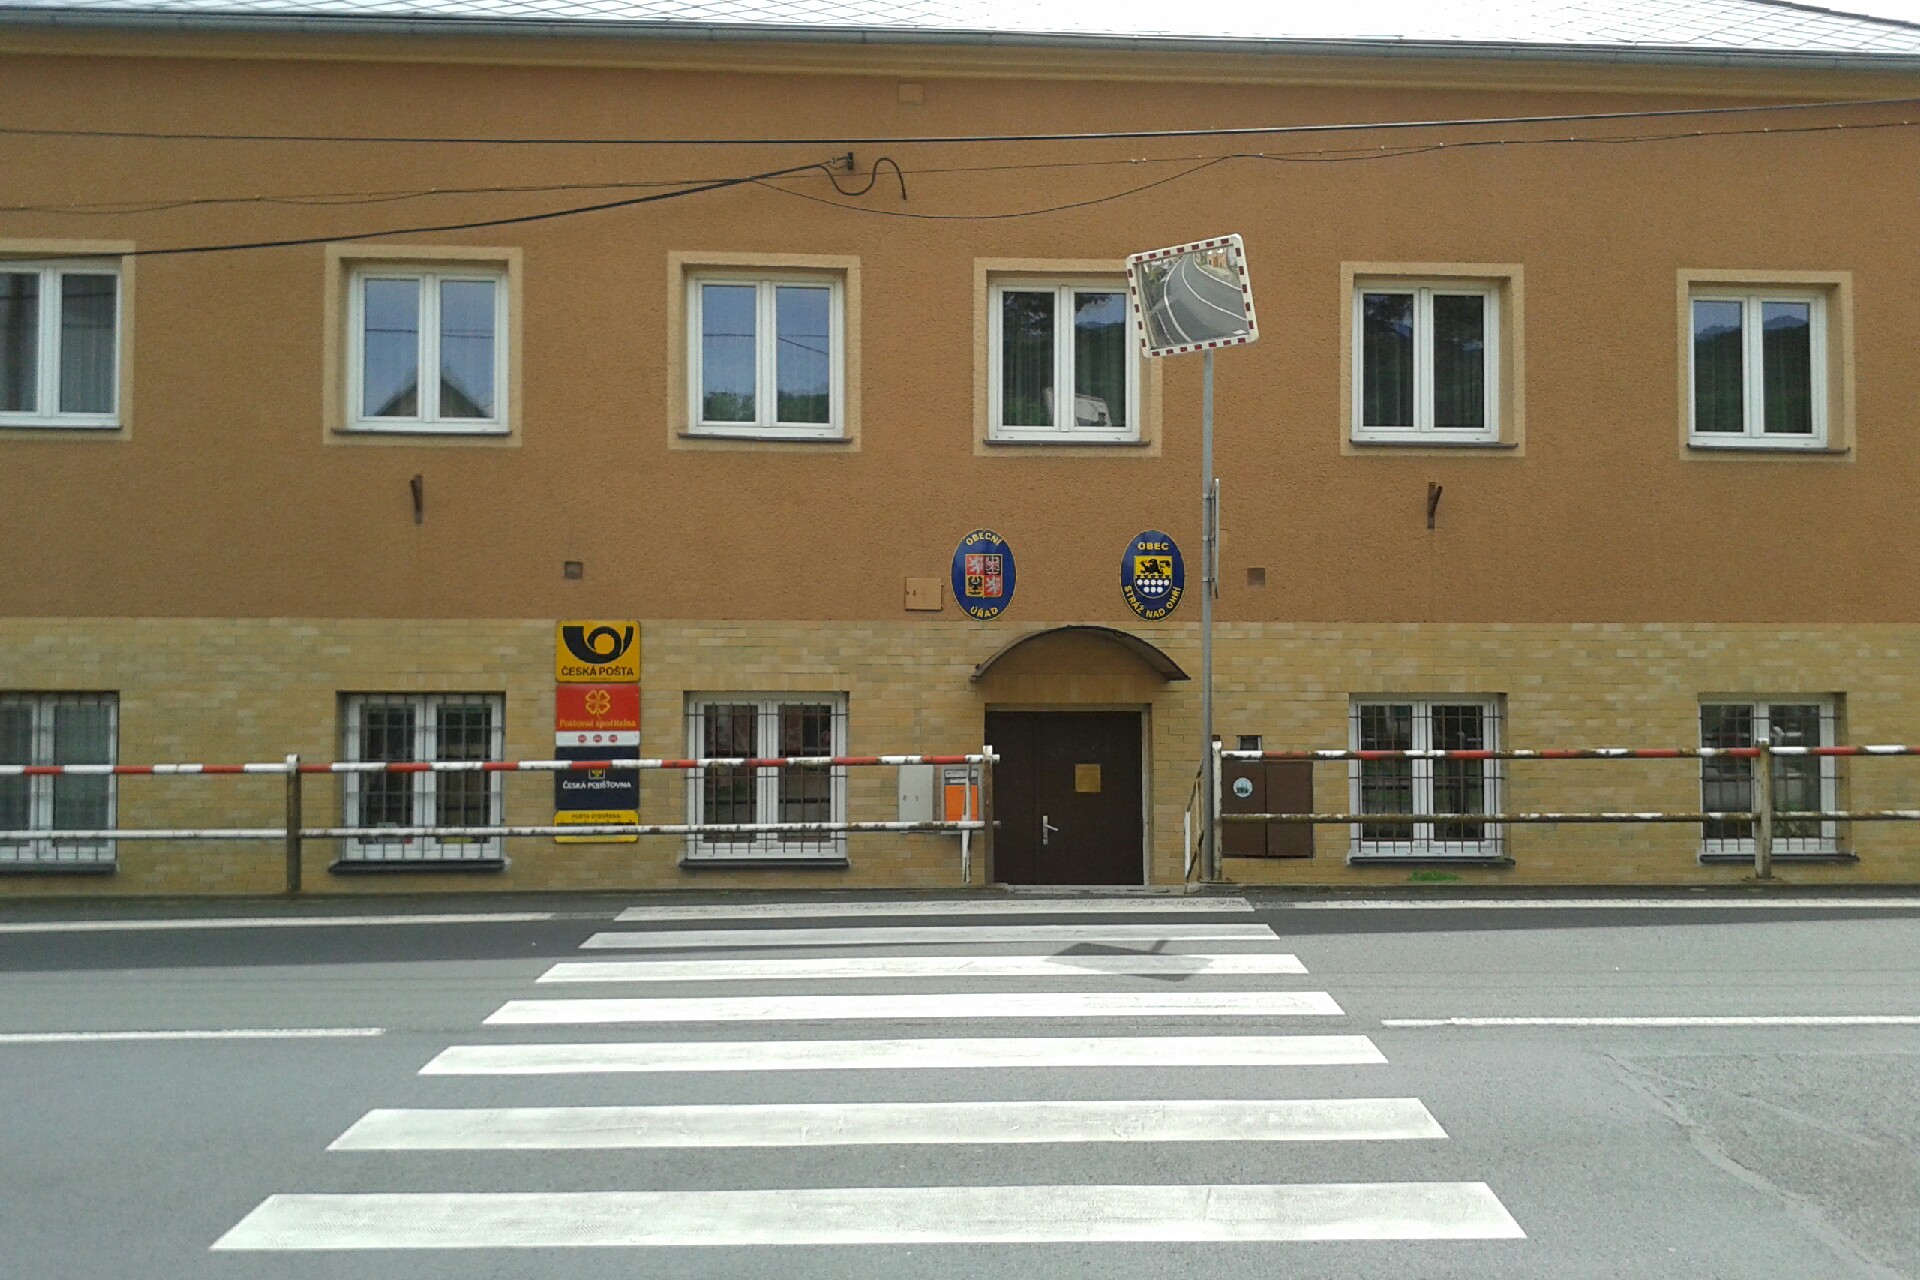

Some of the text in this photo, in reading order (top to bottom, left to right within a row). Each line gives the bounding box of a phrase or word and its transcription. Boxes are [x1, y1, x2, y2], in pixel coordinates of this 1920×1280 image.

[1137, 541, 1169, 551] OBEC
[1145, 608, 1166, 618] NAD
[561, 666, 634, 676] ČESKÁ POŠTA
[562, 780, 587, 790] ČESKÁ
